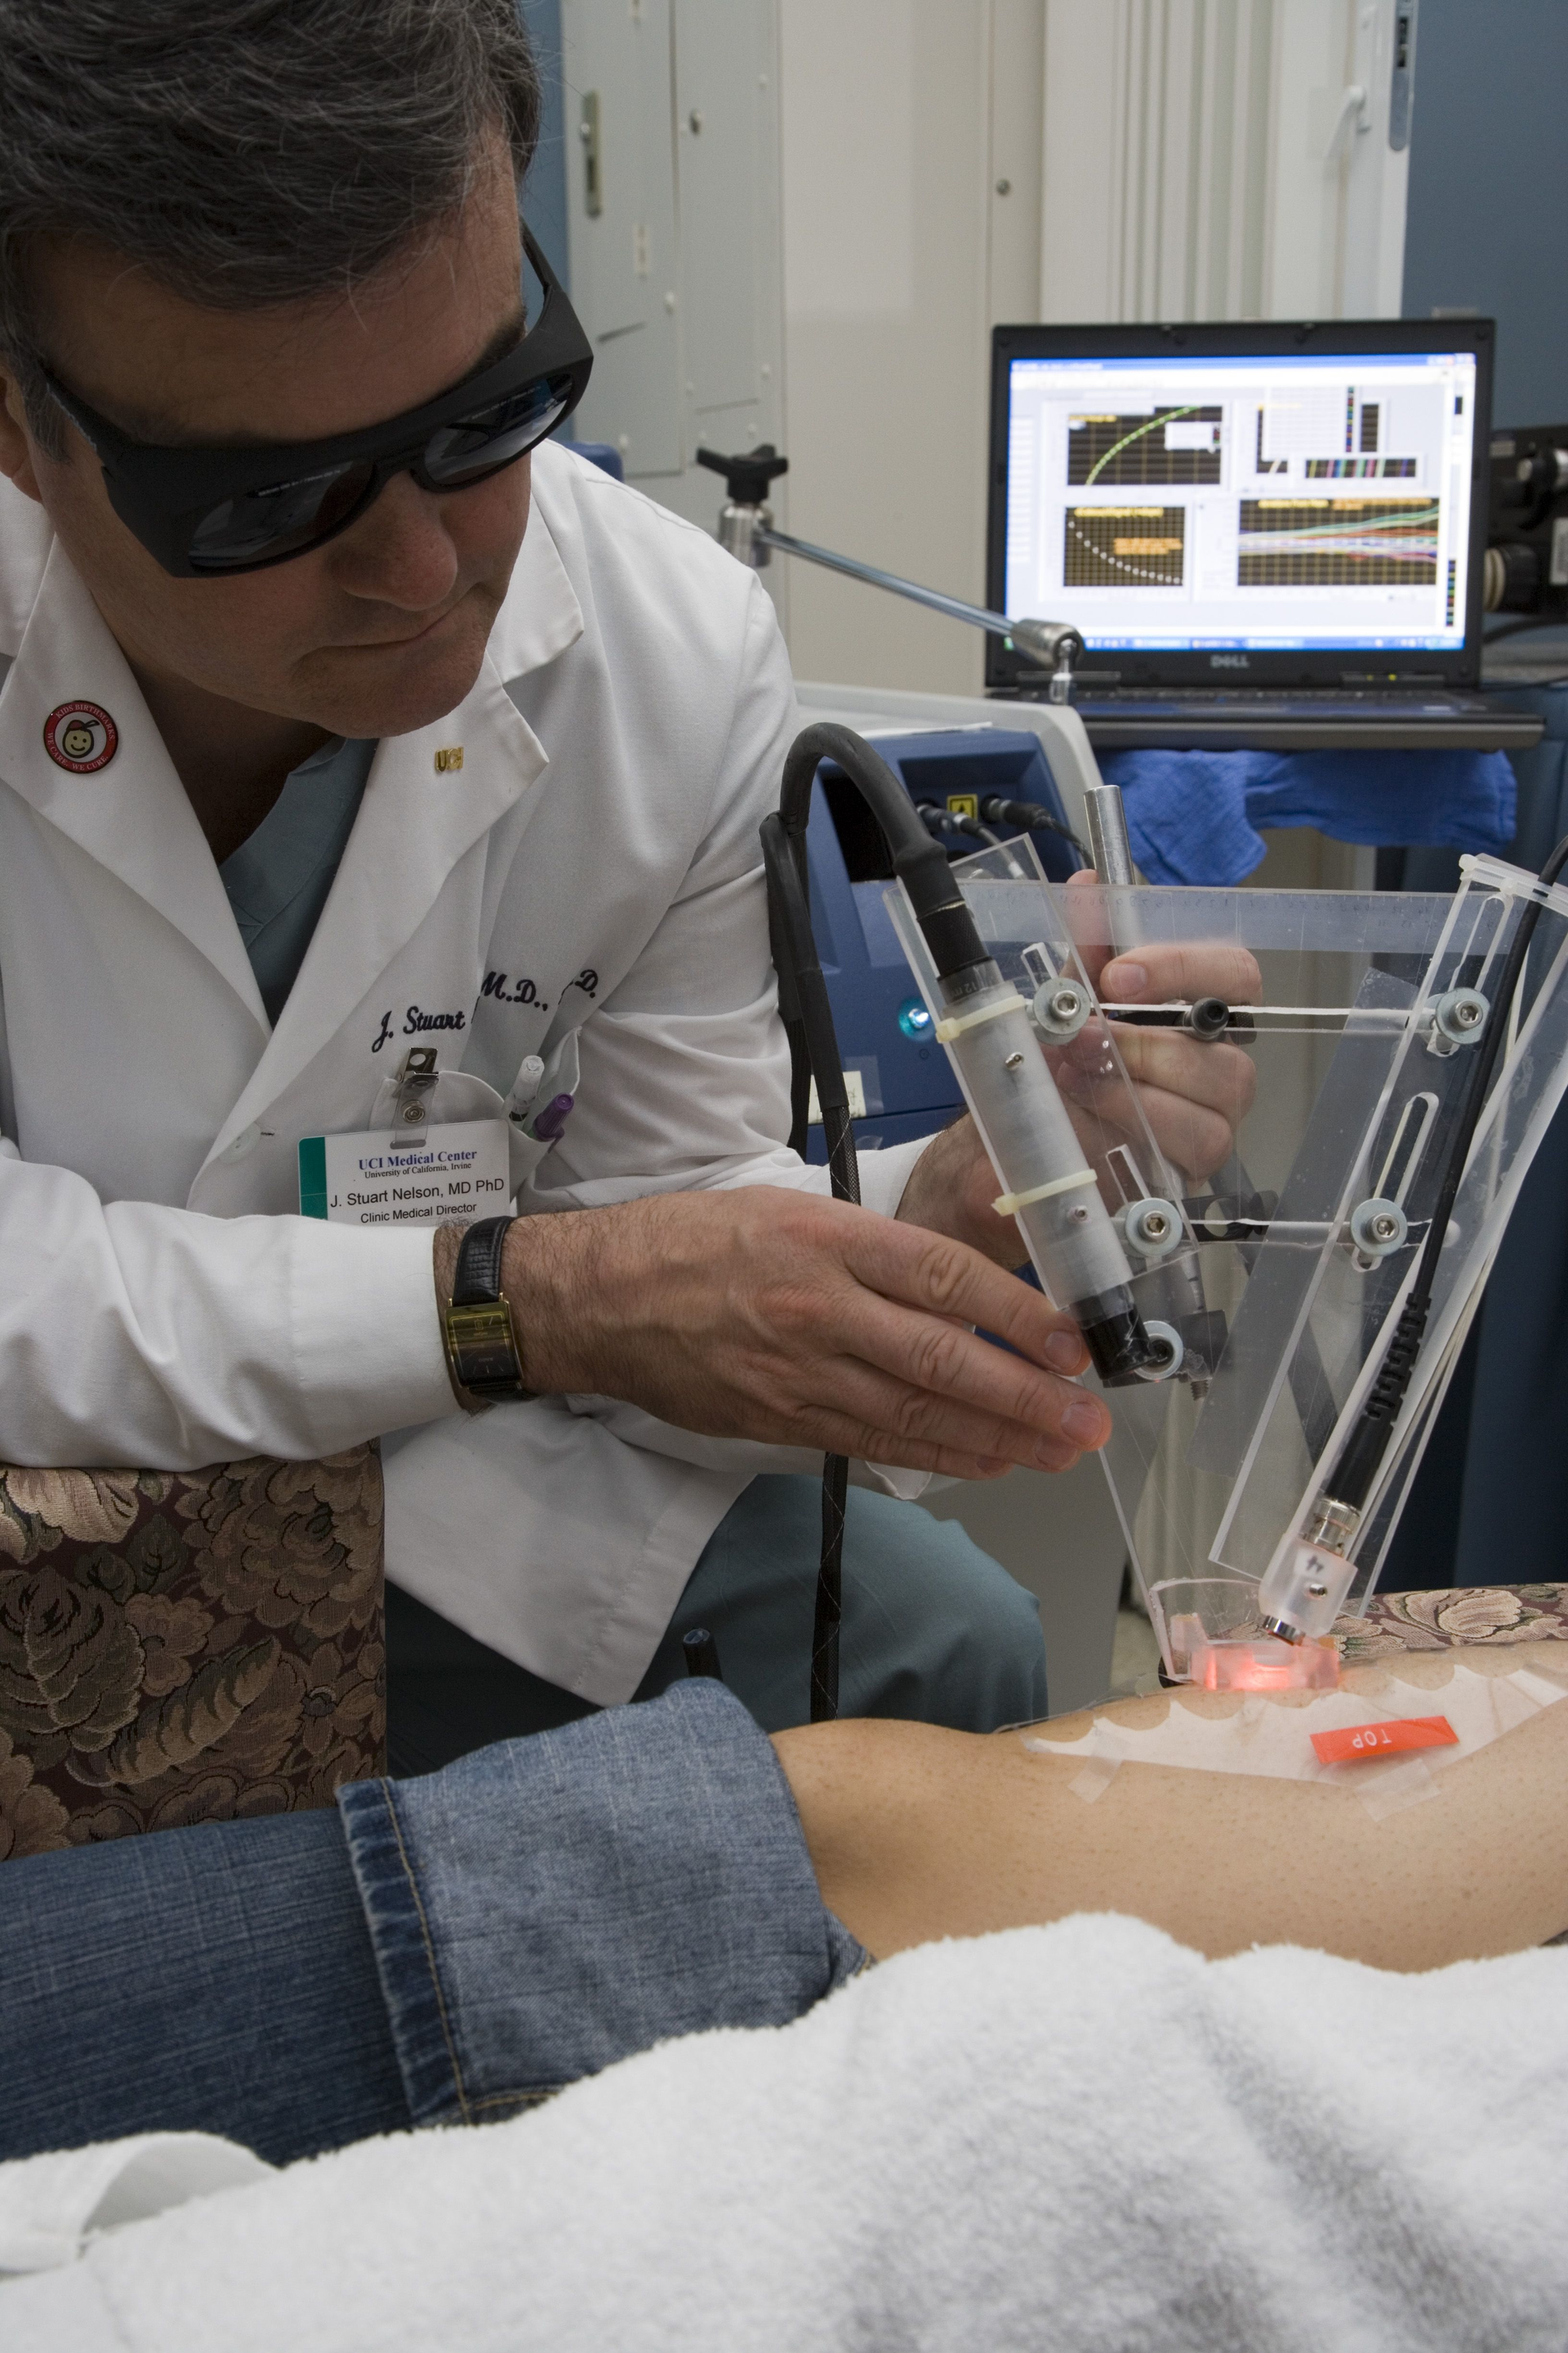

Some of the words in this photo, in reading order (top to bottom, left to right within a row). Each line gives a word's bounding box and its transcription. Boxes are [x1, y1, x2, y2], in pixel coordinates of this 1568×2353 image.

[1209, 654, 1250, 669] DELL
[56, 704, 74, 719] KIDS
[47, 732, 54, 745] WE
[72, 763, 85, 771] WE
[372, 1011, 394, 1053] J.
[403, 1006, 466, 1034] Stuart
[359, 1158, 383, 1170] UCI
[387, 1152, 434, 1167] Medical
[437, 1150, 477, 1162] Center
[364, 1168, 401, 1179] University
[412, 1164, 449, 1174] California,
[451, 1161, 472, 1170] Irvine
[330, 1195, 341, 1207] J.
[347, 1190, 388, 1205] Stuart
[392, 1185, 443, 1202] Nelson,
[448, 1182, 471, 1196] MD
[475, 1179, 505, 1192] PhD
[361, 1212, 390, 1223] Clinic
[392, 1206, 433, 1219] Medical
[436, 1202, 477, 1215] Director
[1352, 1729, 1392, 1749] TOP
